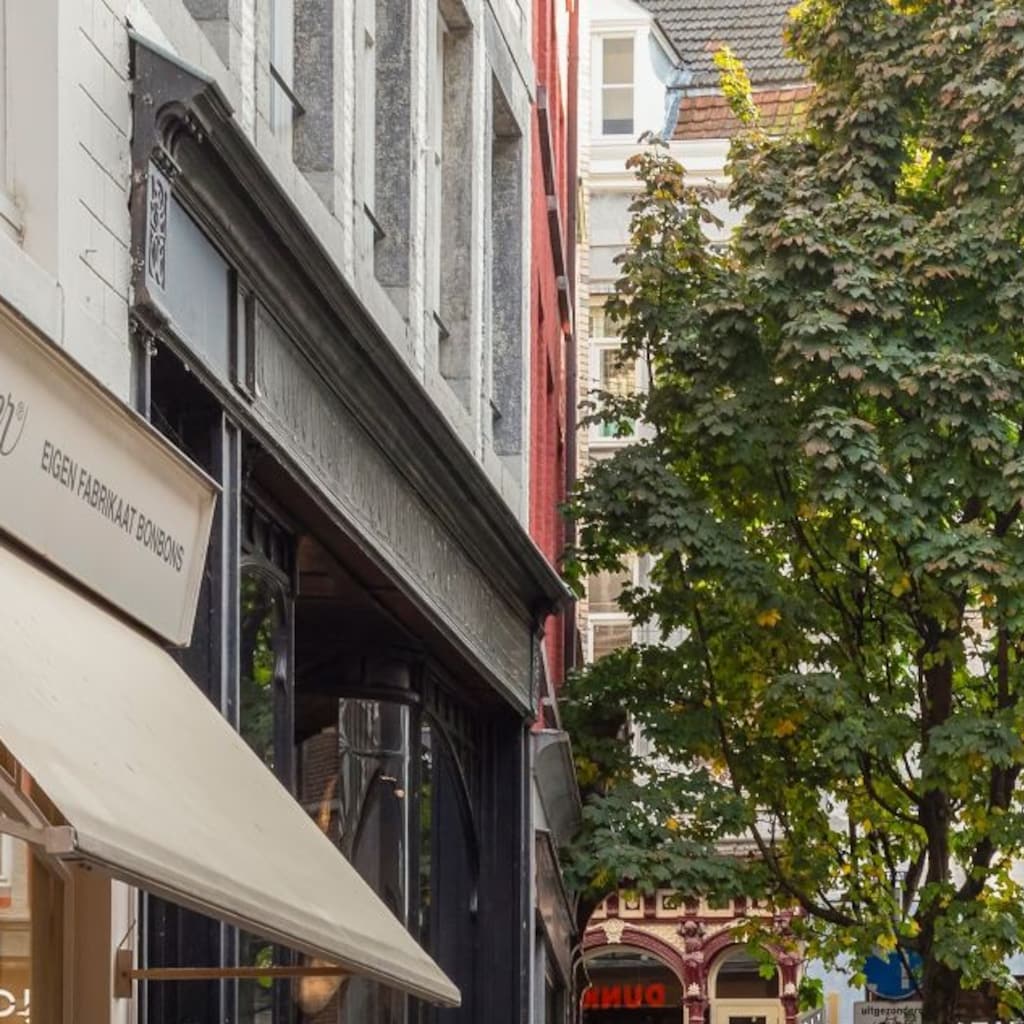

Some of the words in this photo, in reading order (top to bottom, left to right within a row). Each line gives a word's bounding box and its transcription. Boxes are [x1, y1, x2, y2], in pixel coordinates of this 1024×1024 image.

[40, 439, 78, 492] EIGEN
[77, 467, 137, 535] FABRIKAAT
[136, 514, 185, 573] BONBONS
